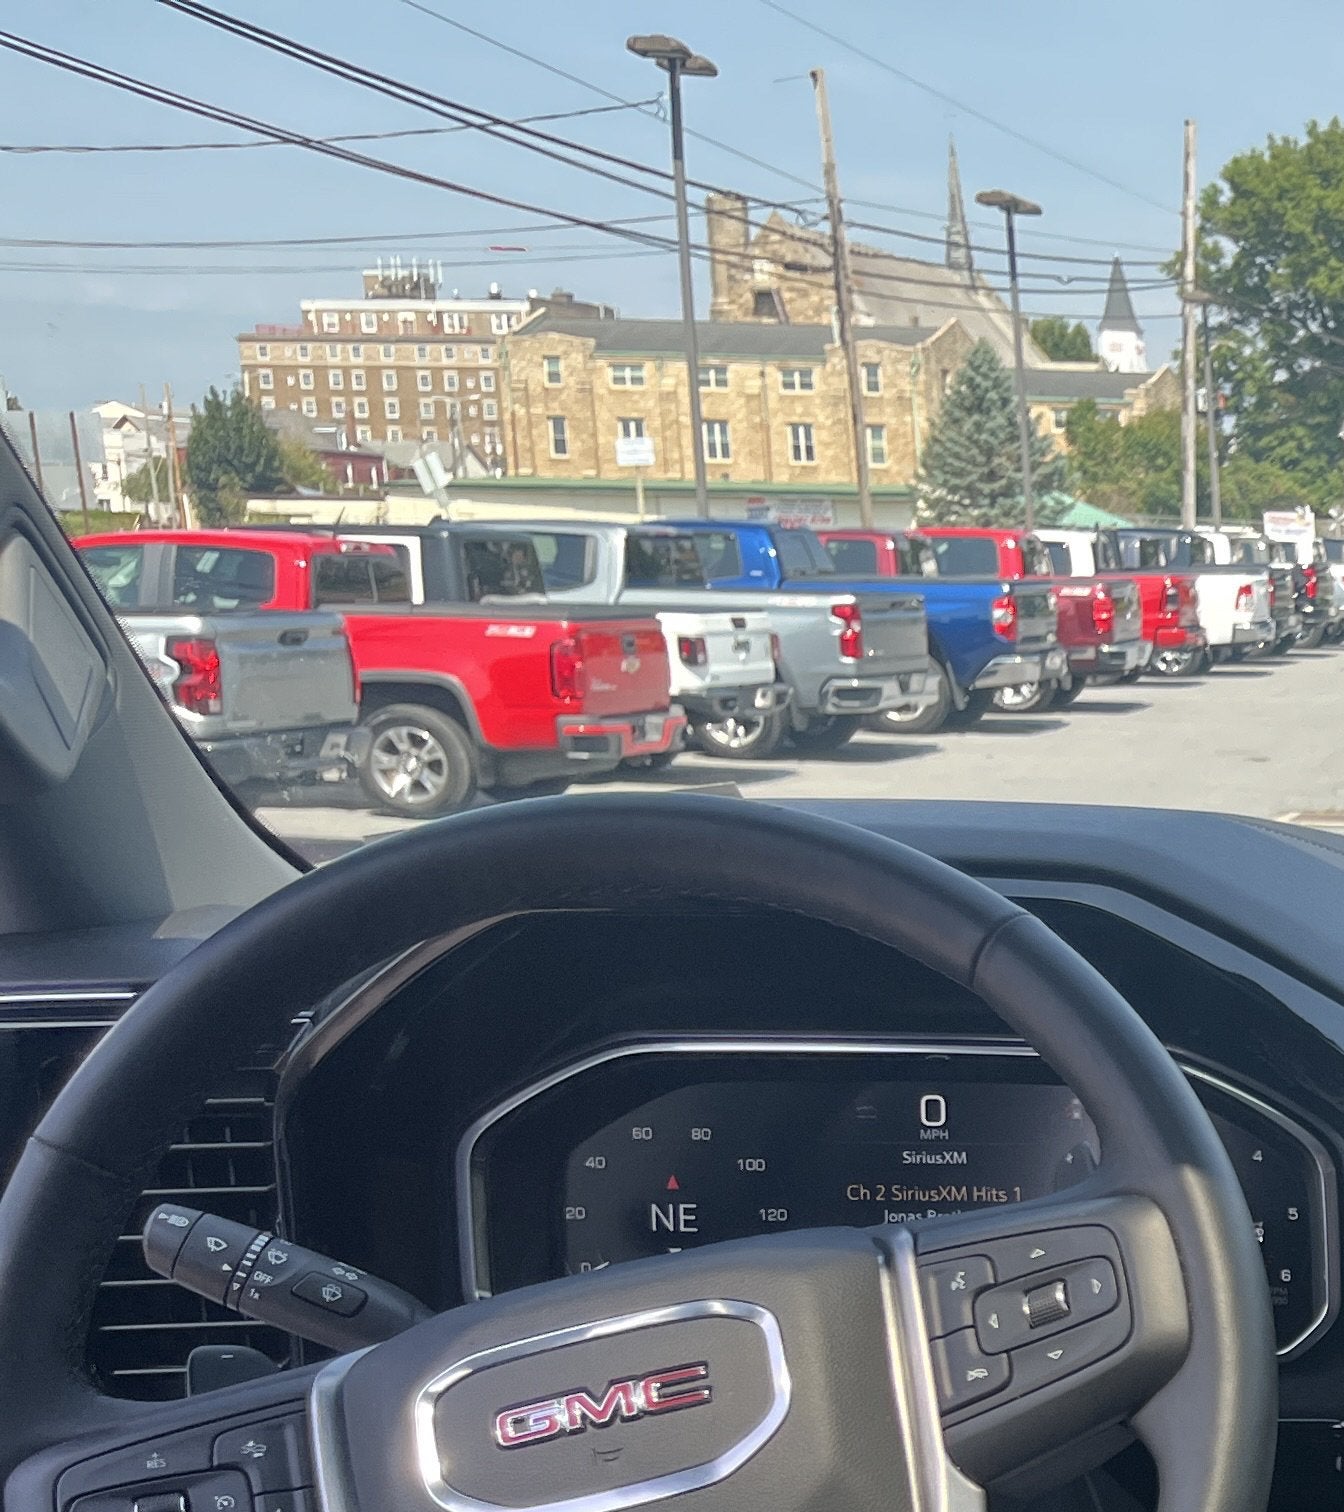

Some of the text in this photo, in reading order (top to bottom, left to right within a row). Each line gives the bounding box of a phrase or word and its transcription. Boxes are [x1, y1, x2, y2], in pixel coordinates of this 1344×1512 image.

[920, 1094, 947, 1127] 0
[632, 1127, 653, 1140] 60
[691, 1128, 712, 1140] 80
[920, 1129, 949, 1140] MPH
[585, 1156, 606, 1169] 40
[902, 1151, 967, 1165] SiriusXM
[1252, 1150, 1263, 1163] 4
[737, 1159, 766, 1172] 100
[846, 1184, 1022, 1202] Ch 2 SiriusXM Hits 1
[565, 1206, 586, 1220] 20
[651, 1204, 698, 1233] NE
[759, 1208, 788, 1222] 120
[884, 1209, 923, 1224] Jonas
[1288, 1207, 1299, 1221] 5
[254, 1270, 274, 1284] OFF
[1281, 1269, 1291, 1282] 6
[495, 1363, 711, 1447] GMC
